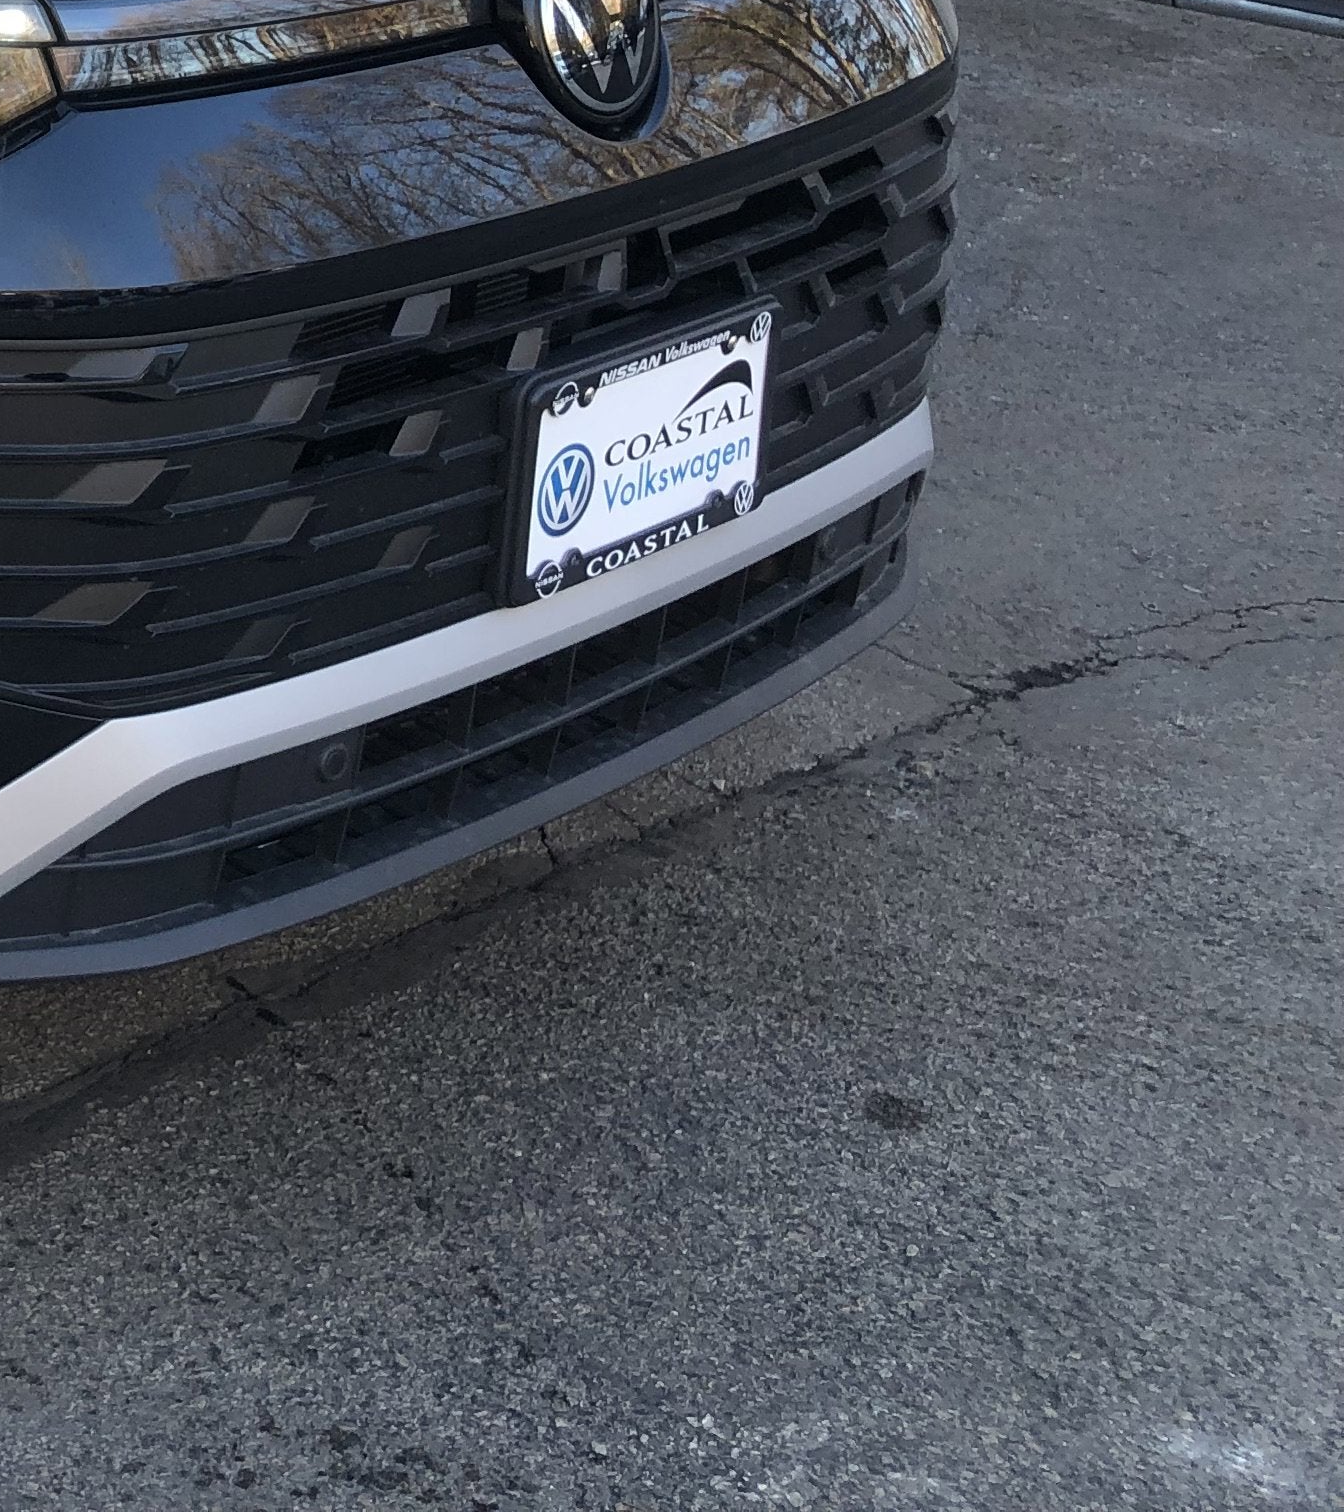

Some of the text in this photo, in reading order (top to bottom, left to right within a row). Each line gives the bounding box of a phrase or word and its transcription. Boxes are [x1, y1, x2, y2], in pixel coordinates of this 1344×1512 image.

[599, 330, 731, 387] NISSAN Volkswagen
[604, 394, 754, 467] COASTAL
[603, 436, 751, 513] Volkswagen
[586, 514, 710, 578] COASTAL
